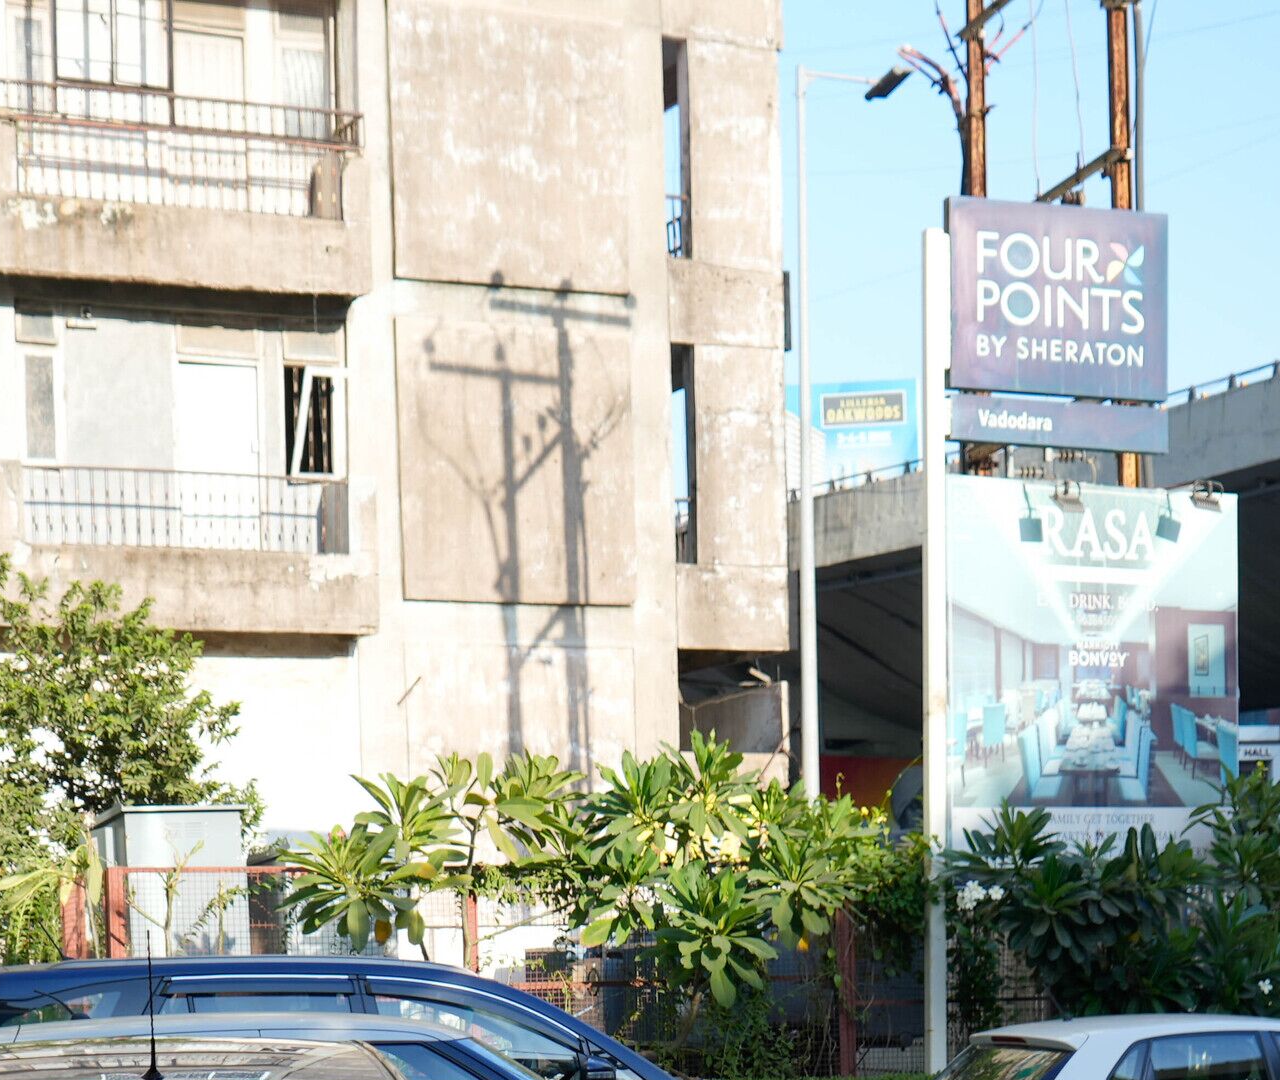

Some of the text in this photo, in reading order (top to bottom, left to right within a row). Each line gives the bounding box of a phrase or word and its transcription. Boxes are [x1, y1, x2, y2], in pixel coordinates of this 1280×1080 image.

[976, 230, 1105, 283] FOUR
[976, 280, 1145, 335] POINTS
[976, 334, 1144, 368] BY SHERATON
[978, 408, 1052, 432] Vadodara
[1037, 505, 1157, 562] RASA
[1069, 650, 1127, 668] BONVOY
[1244, 746, 1271, 757] HALL
[1051, 813, 1155, 825] AMILY GET TOGETHER
